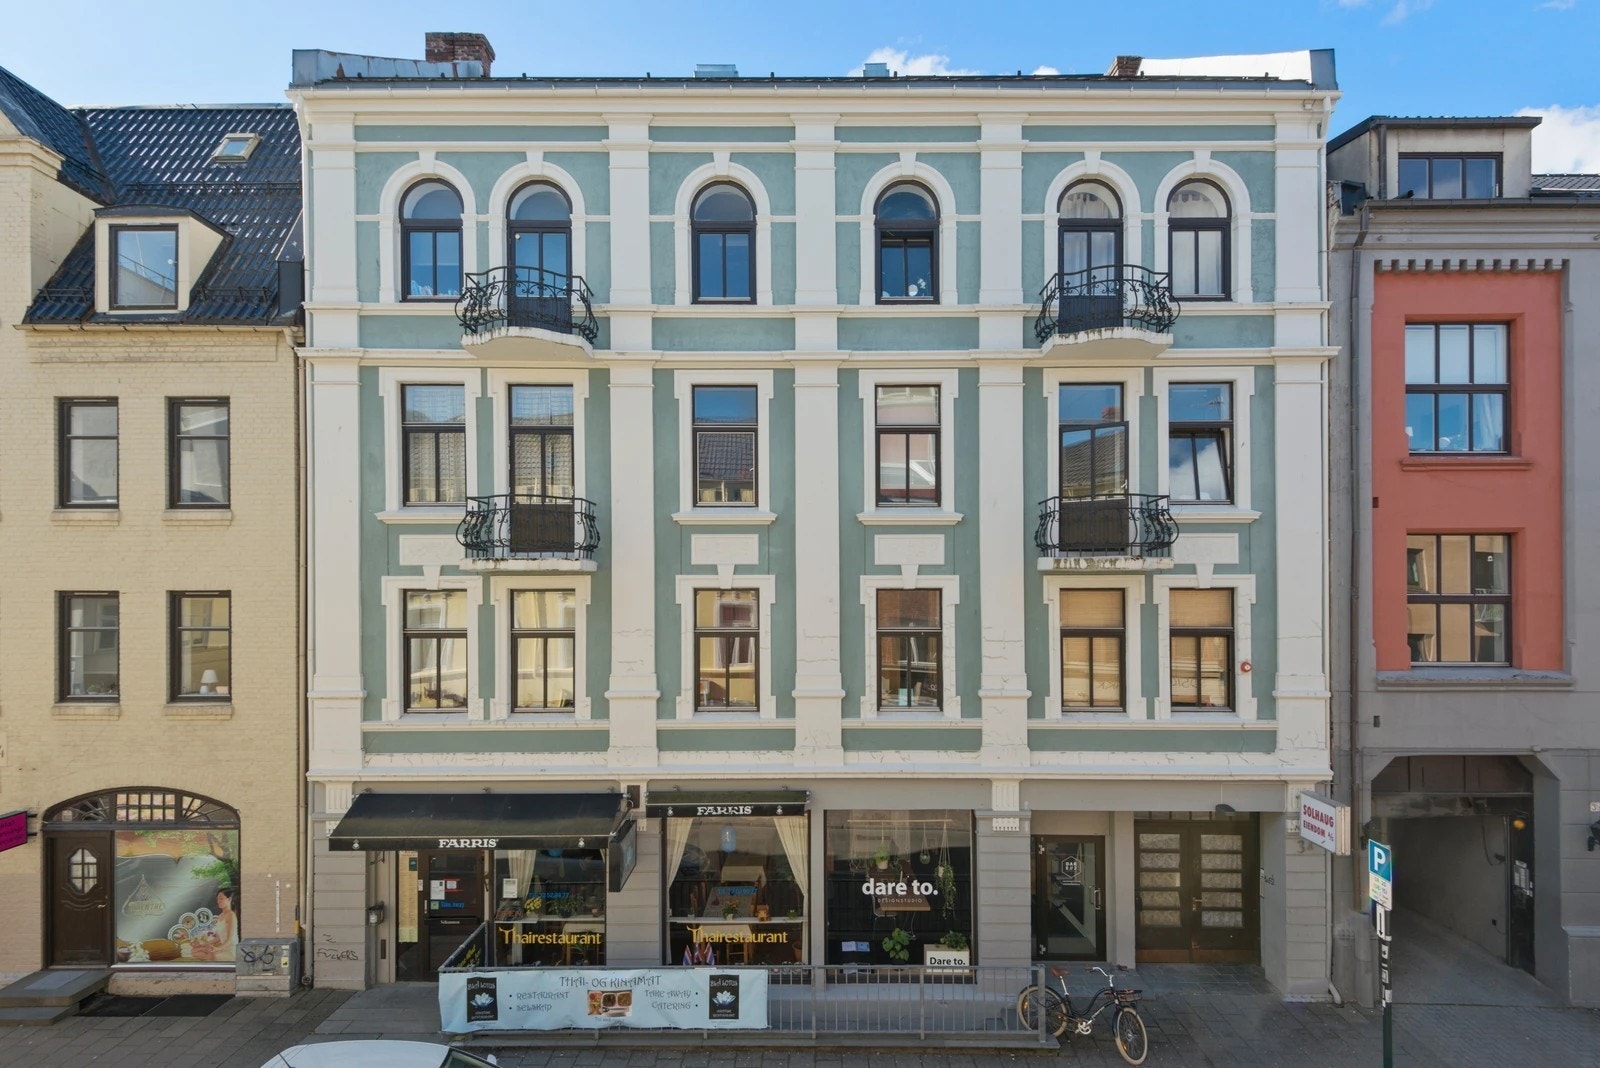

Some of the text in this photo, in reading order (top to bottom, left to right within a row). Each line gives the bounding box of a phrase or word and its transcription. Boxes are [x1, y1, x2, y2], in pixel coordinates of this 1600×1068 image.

[696, 806, 752, 816] FARRIS
[1303, 804, 1334, 828] SOLHAUG
[1303, 820, 1326, 838] EIENDOM
[438, 838, 499, 849] FARRIS
[1374, 846, 1386, 872] P
[862, 878, 938, 895] dare to.
[498, 926, 602, 945] Thairestaurant
[686, 925, 788, 943] Thairestaurant
[929, 957, 966, 966] Dare to.
[591, 977, 607, 988] OG
[610, 975, 662, 989] KINAMAT
